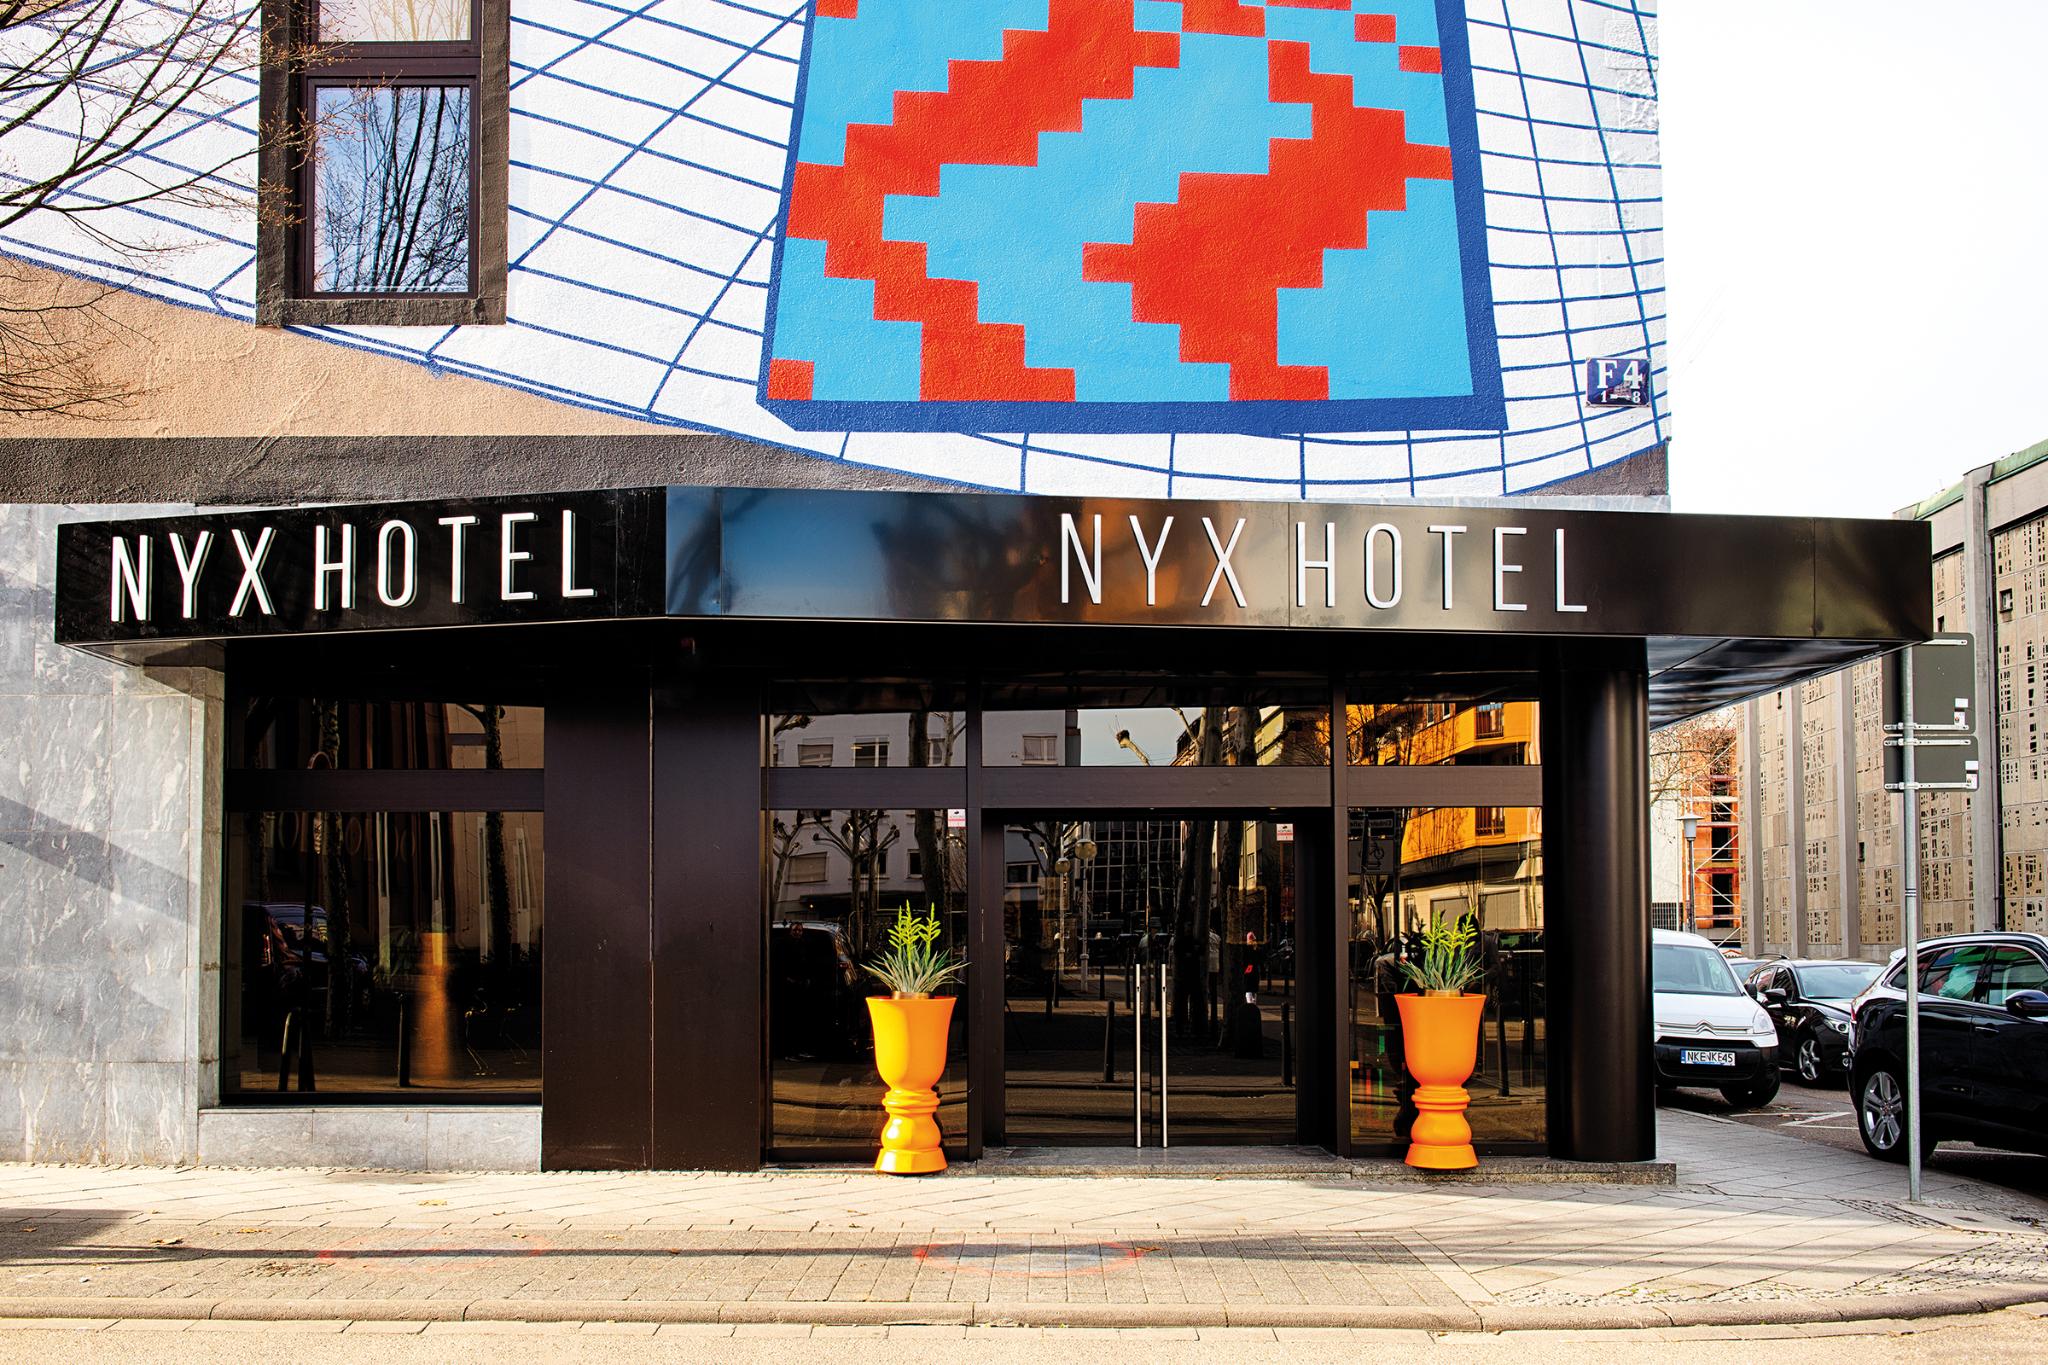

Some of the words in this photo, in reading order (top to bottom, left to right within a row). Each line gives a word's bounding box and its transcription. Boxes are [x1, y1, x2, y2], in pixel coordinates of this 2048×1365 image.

[110, 526, 276, 623] NYX
[314, 508, 598, 611] HOTEL
[1060, 513, 1248, 608] NYX
[1296, 521, 1588, 613] HOTEL
